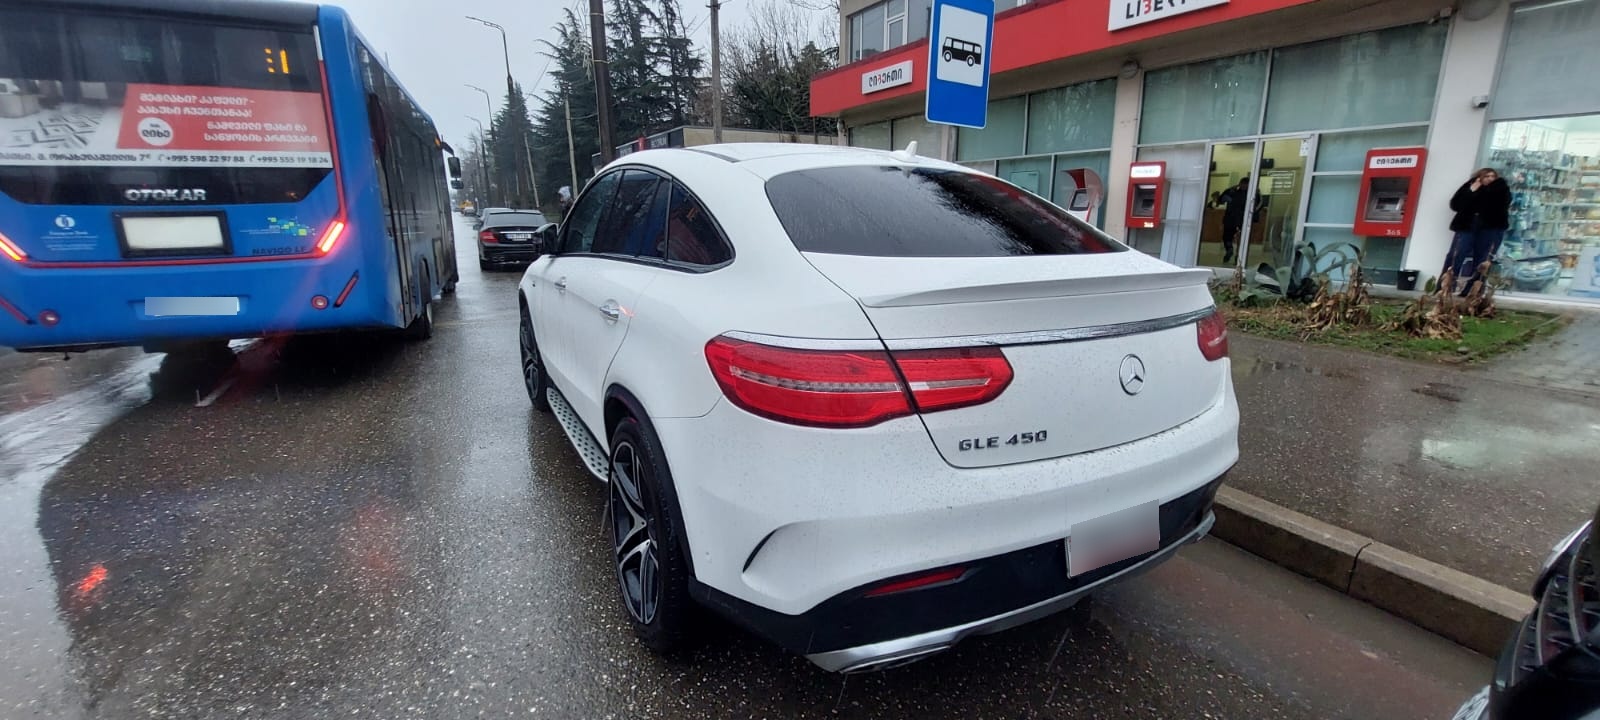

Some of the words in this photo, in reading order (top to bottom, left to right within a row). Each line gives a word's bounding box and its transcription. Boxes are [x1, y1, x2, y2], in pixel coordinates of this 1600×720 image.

[167, 154, 189, 162] +995
[125, 188, 206, 201] OTOKAR
[958, 436, 1000, 452] GLE
[1005, 430, 1047, 446] 450
